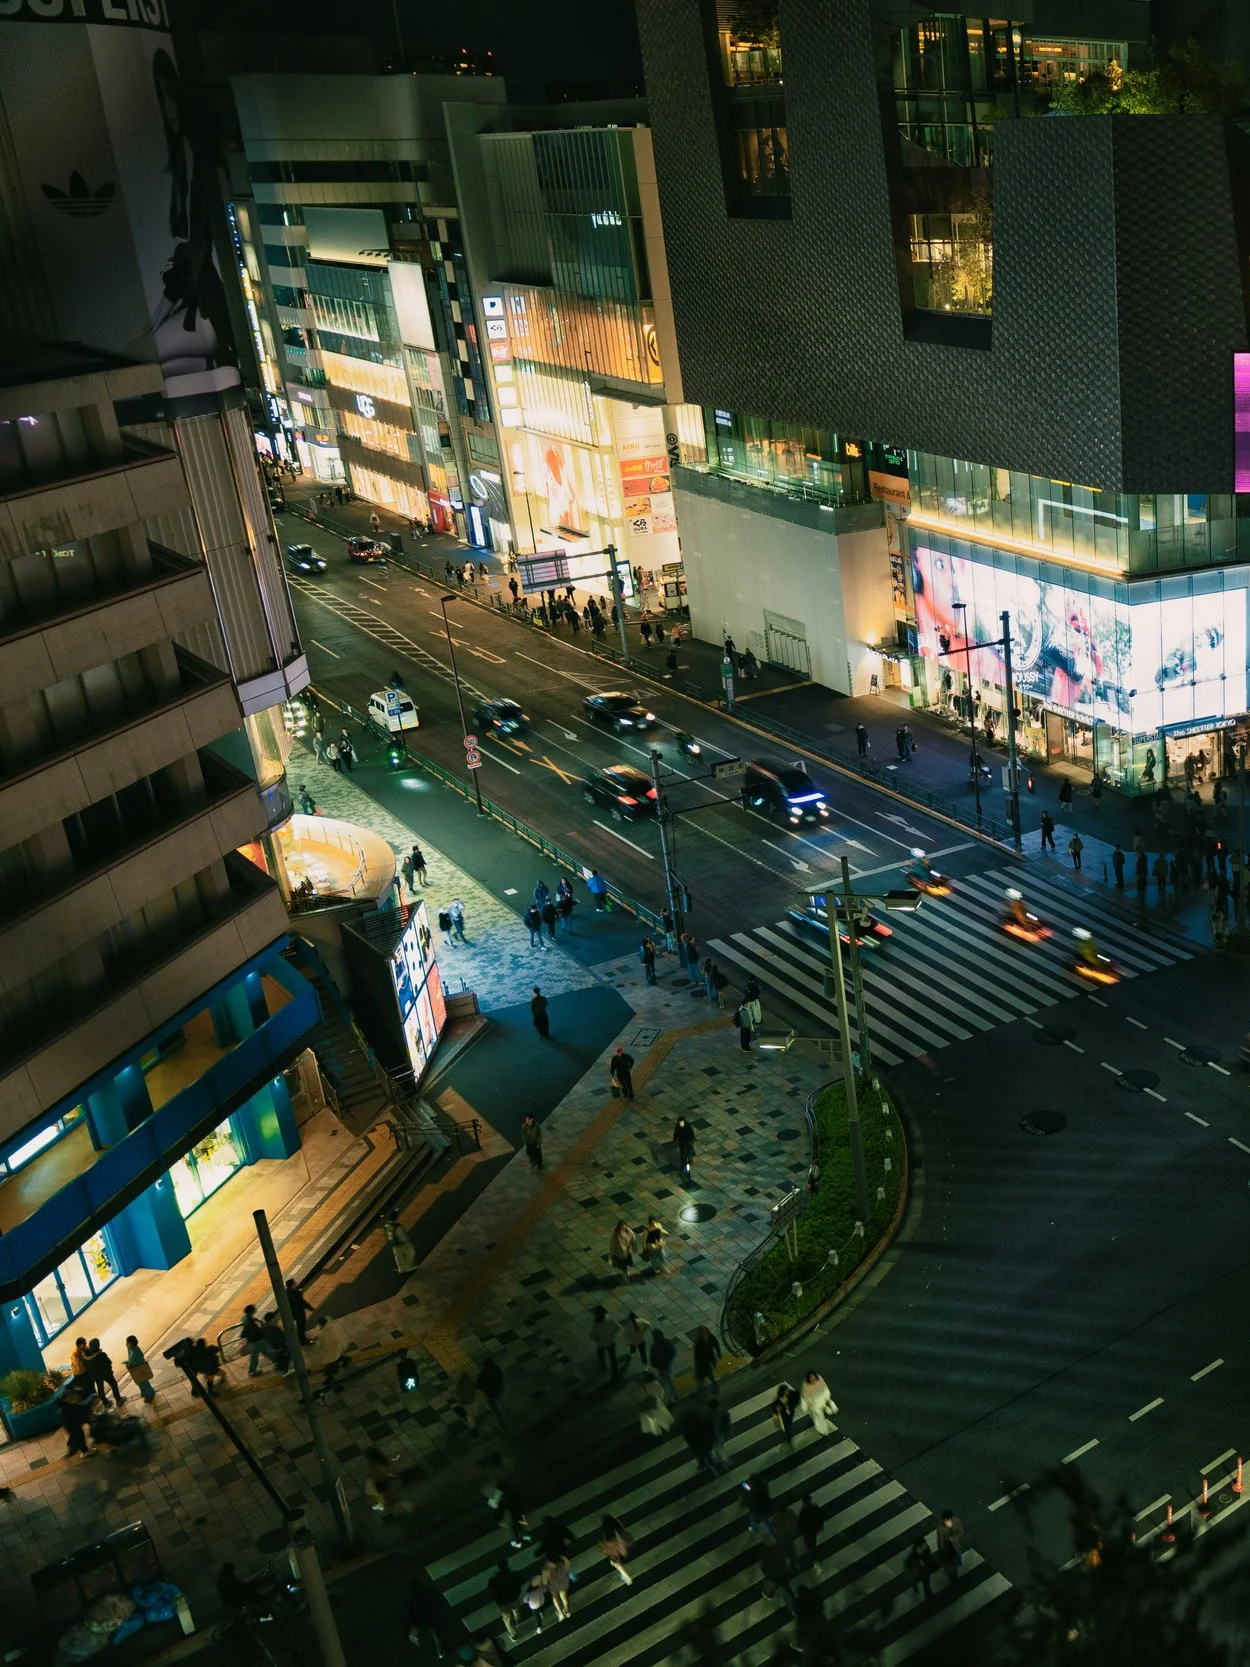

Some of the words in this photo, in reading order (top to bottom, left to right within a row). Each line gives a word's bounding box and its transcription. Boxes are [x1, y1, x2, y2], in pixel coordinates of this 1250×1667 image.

[873, 482, 906, 499] Restaurant
[387, 693, 396, 703] P
[1133, 734, 1164, 744] SUPERSTAR
